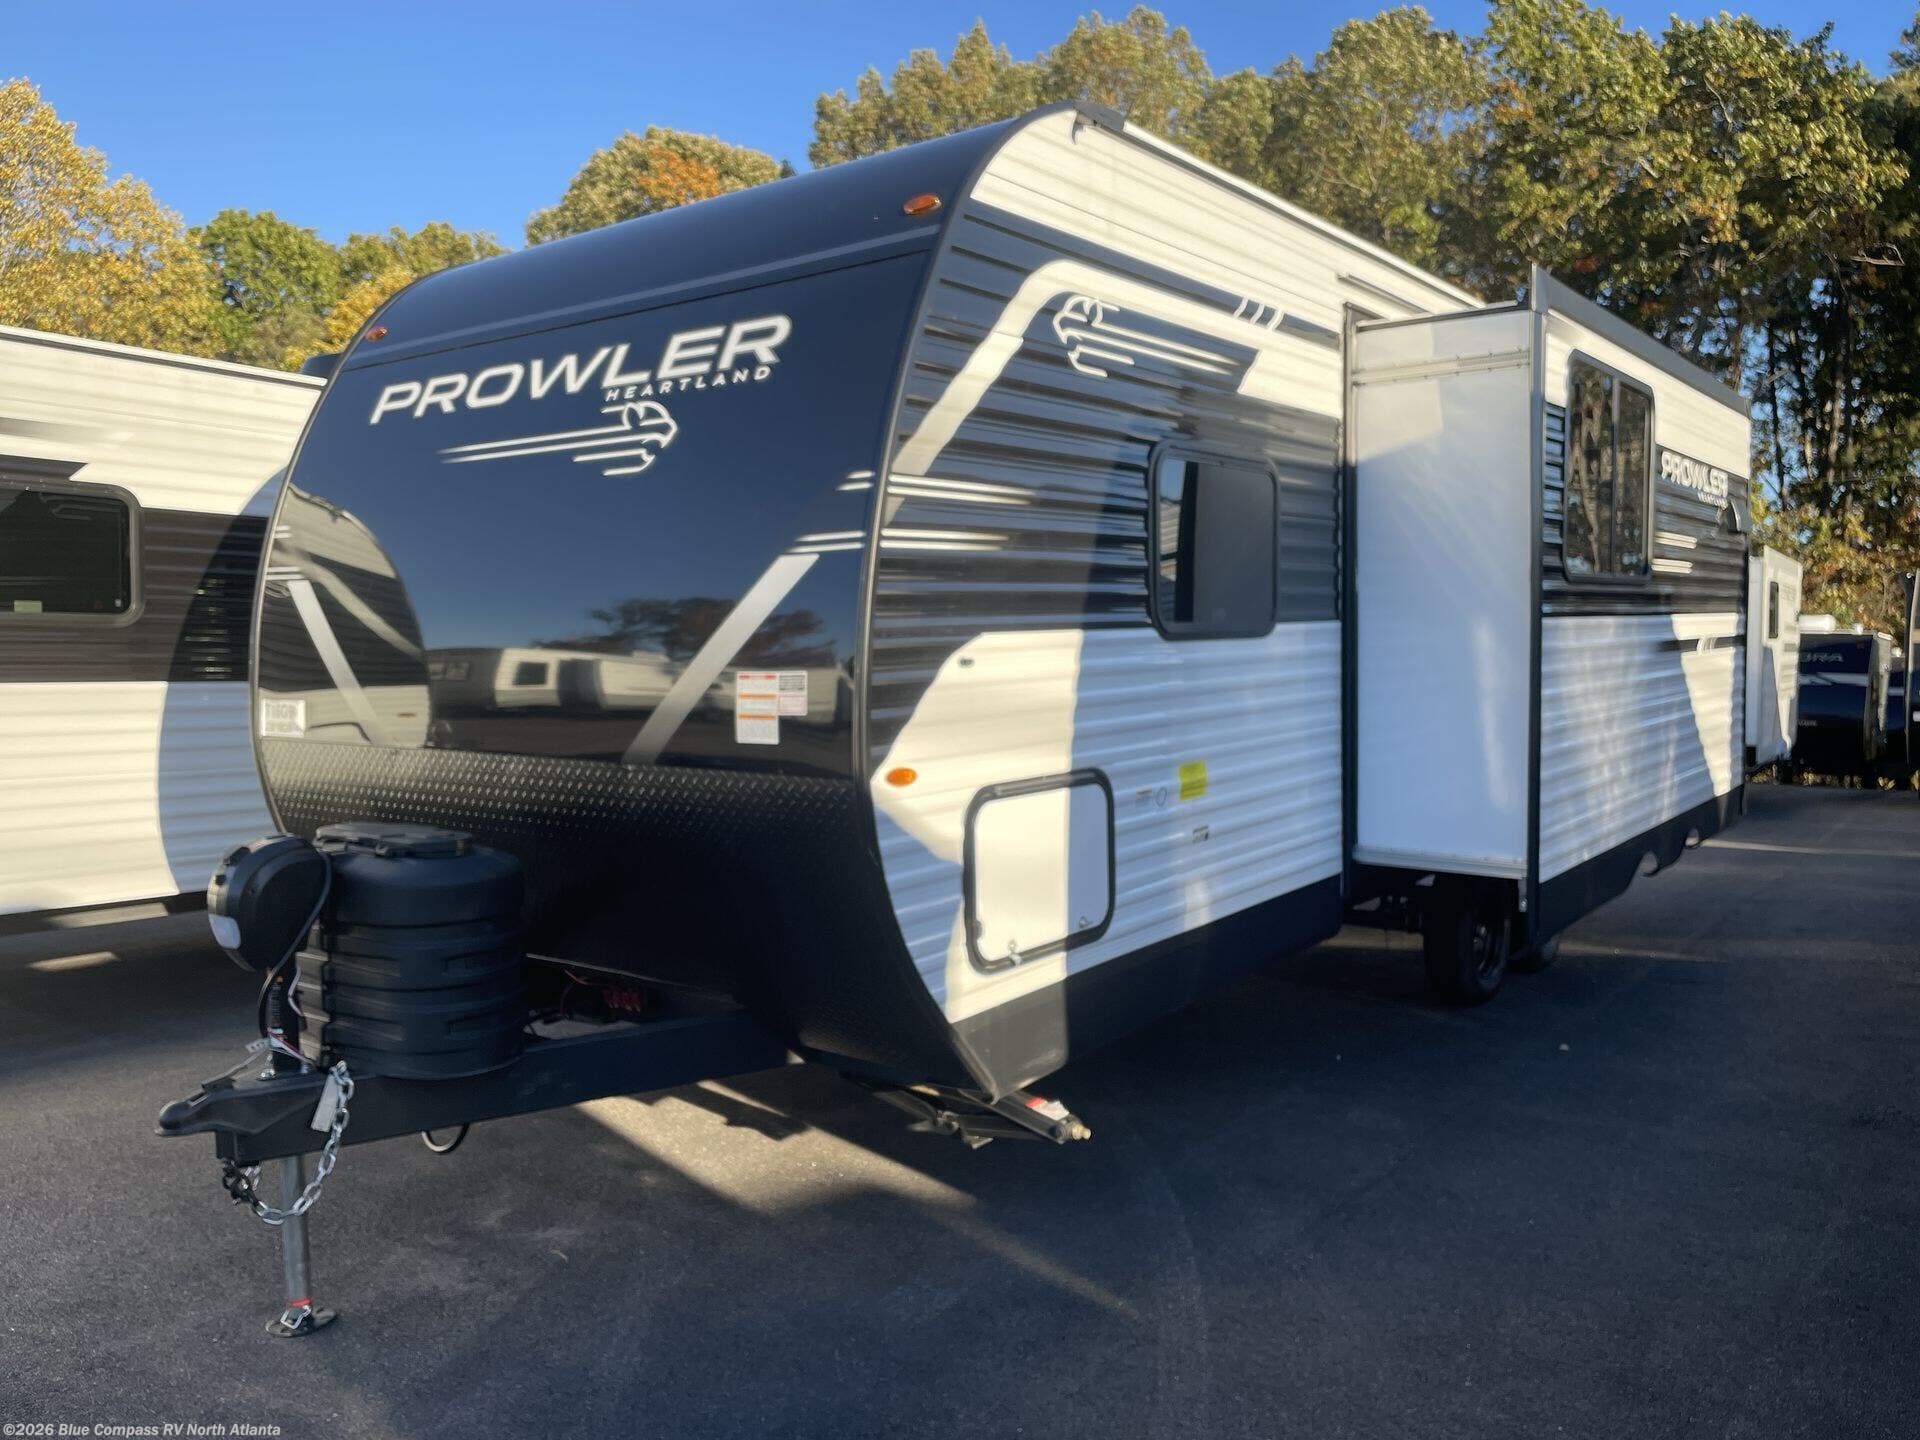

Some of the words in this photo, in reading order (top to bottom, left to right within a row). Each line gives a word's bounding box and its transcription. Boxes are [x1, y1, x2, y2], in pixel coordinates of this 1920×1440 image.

[369, 314, 793, 425] PROWLER
[604, 365, 772, 402] HEARTLAND
[1661, 450, 1729, 499] PROWLER
